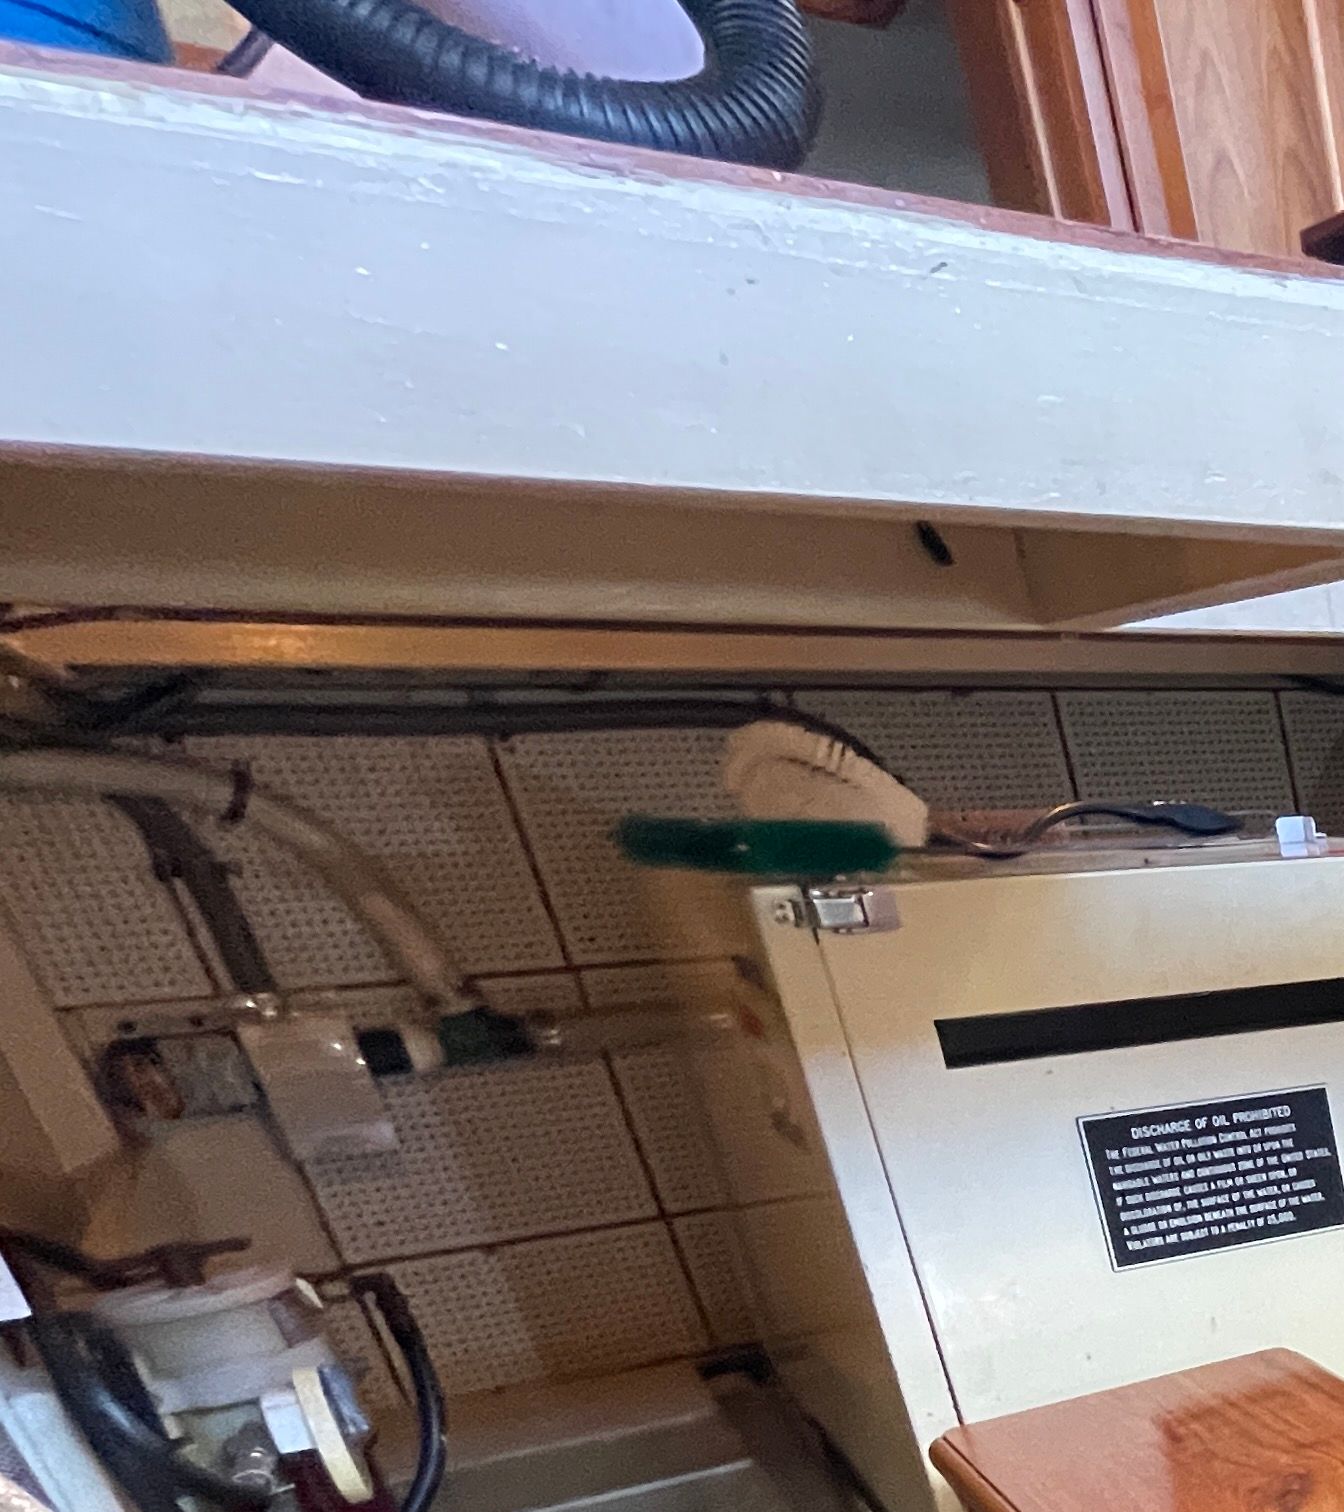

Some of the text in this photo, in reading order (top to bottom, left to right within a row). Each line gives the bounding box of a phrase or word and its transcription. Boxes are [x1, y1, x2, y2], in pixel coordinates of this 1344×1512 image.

[1131, 1106, 1290, 1139] DISCHARGE OF OIL PROHIBITED
